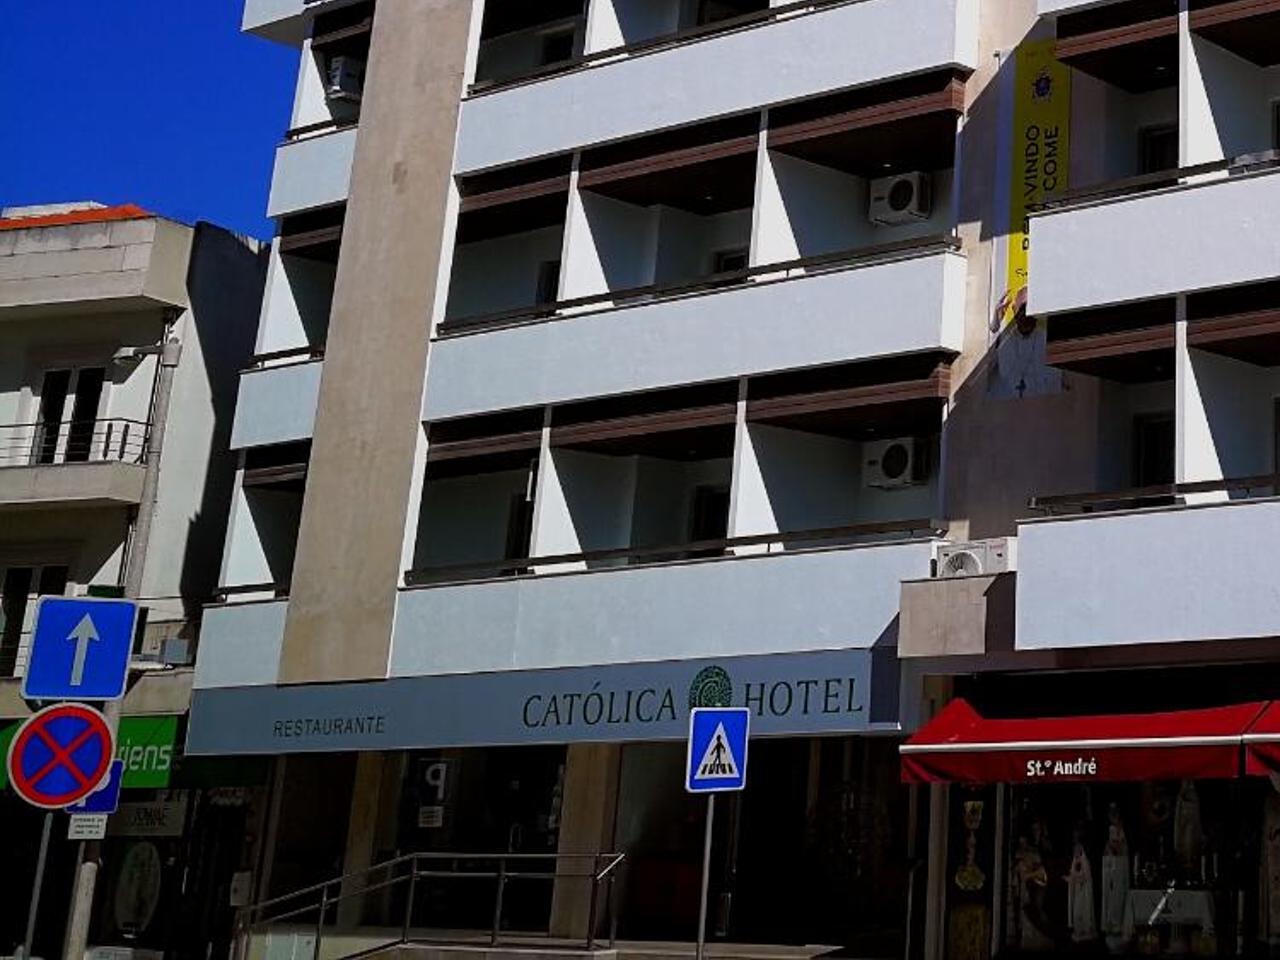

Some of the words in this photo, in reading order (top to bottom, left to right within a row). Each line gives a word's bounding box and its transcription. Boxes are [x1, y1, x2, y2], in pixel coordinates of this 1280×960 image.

[1043, 126, 1059, 191] COME
[523, 680, 677, 728] CATÓLICA
[744, 677, 864, 717] HOTEL
[273, 715, 386, 737] RESTAURANTE
[1054, 757, 1097, 775] André
